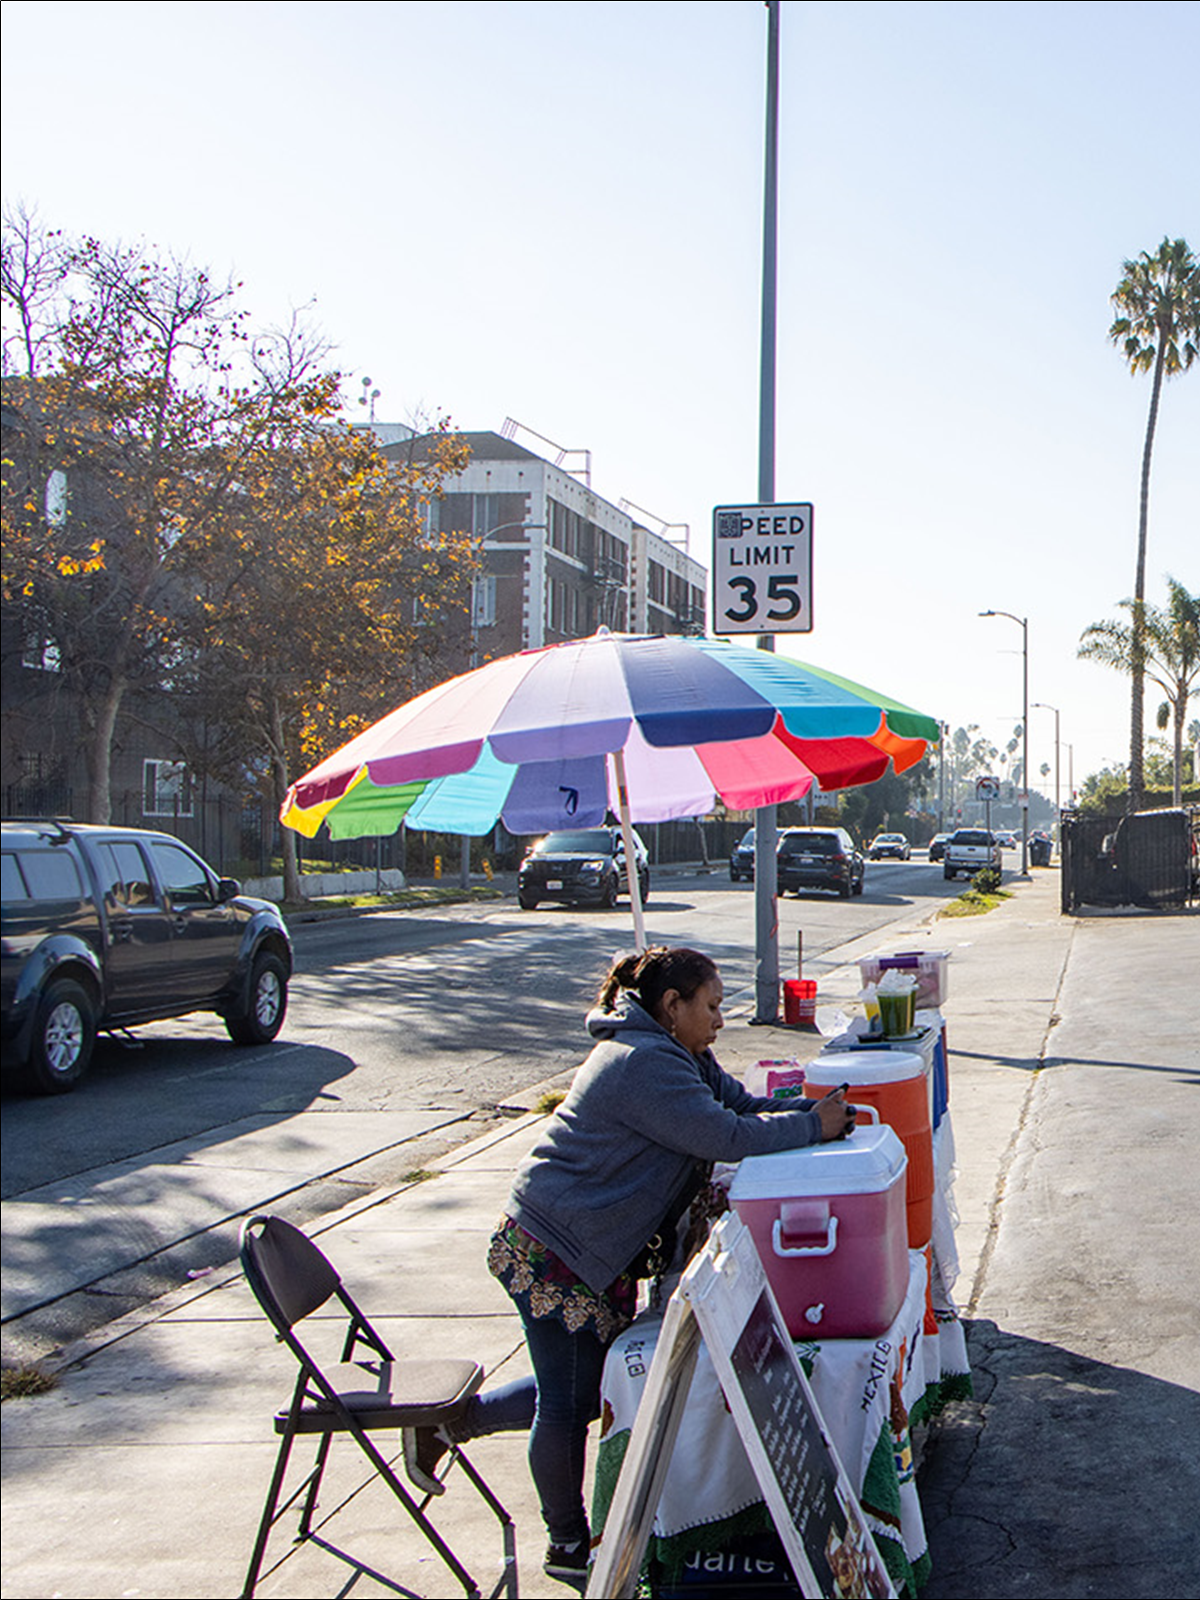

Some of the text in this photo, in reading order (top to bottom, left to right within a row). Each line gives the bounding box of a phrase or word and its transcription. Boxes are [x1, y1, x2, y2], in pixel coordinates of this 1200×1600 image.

[718, 514, 805, 537] PEED
[729, 545, 795, 566] LIMIT
[724, 574, 801, 622] 35
